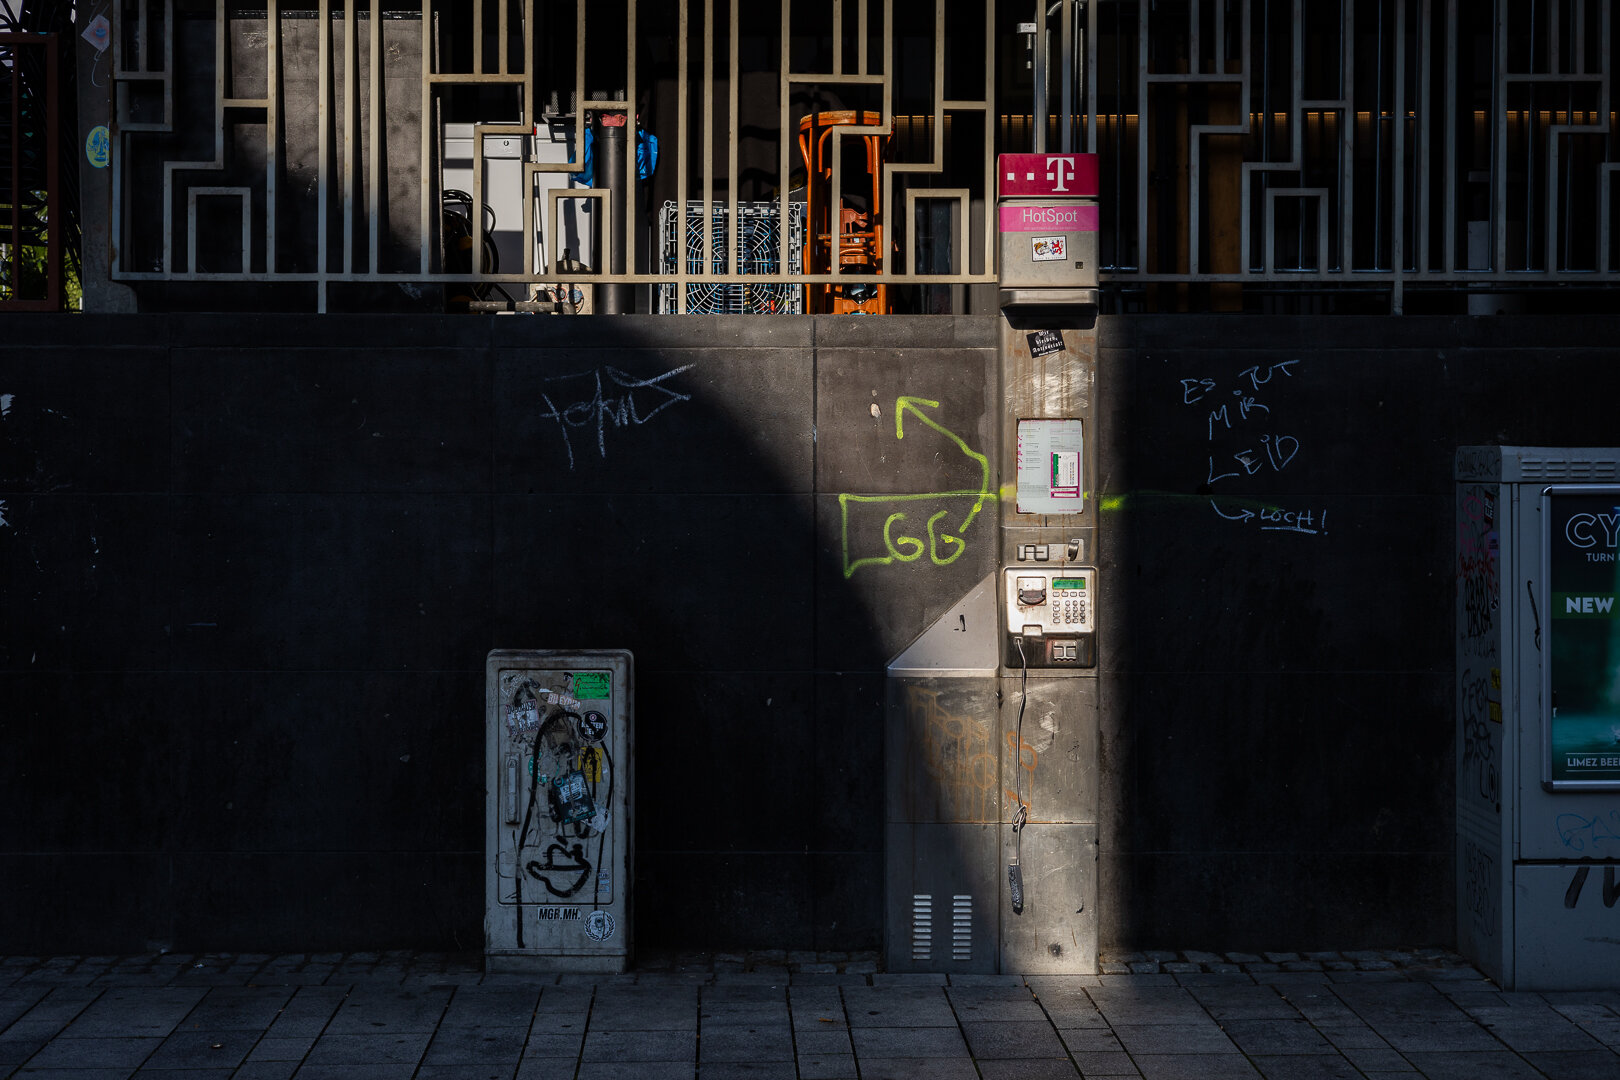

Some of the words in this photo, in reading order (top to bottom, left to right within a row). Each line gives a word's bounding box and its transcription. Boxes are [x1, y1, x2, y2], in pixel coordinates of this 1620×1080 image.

[1023, 208, 1077, 225] HotSpot
[1585, 552, 1615, 562] TURN
[1566, 596, 1614, 614] NEW
[1567, 757, 1597, 767] LIMEZ
[1600, 757, 1620, 767] BEE
